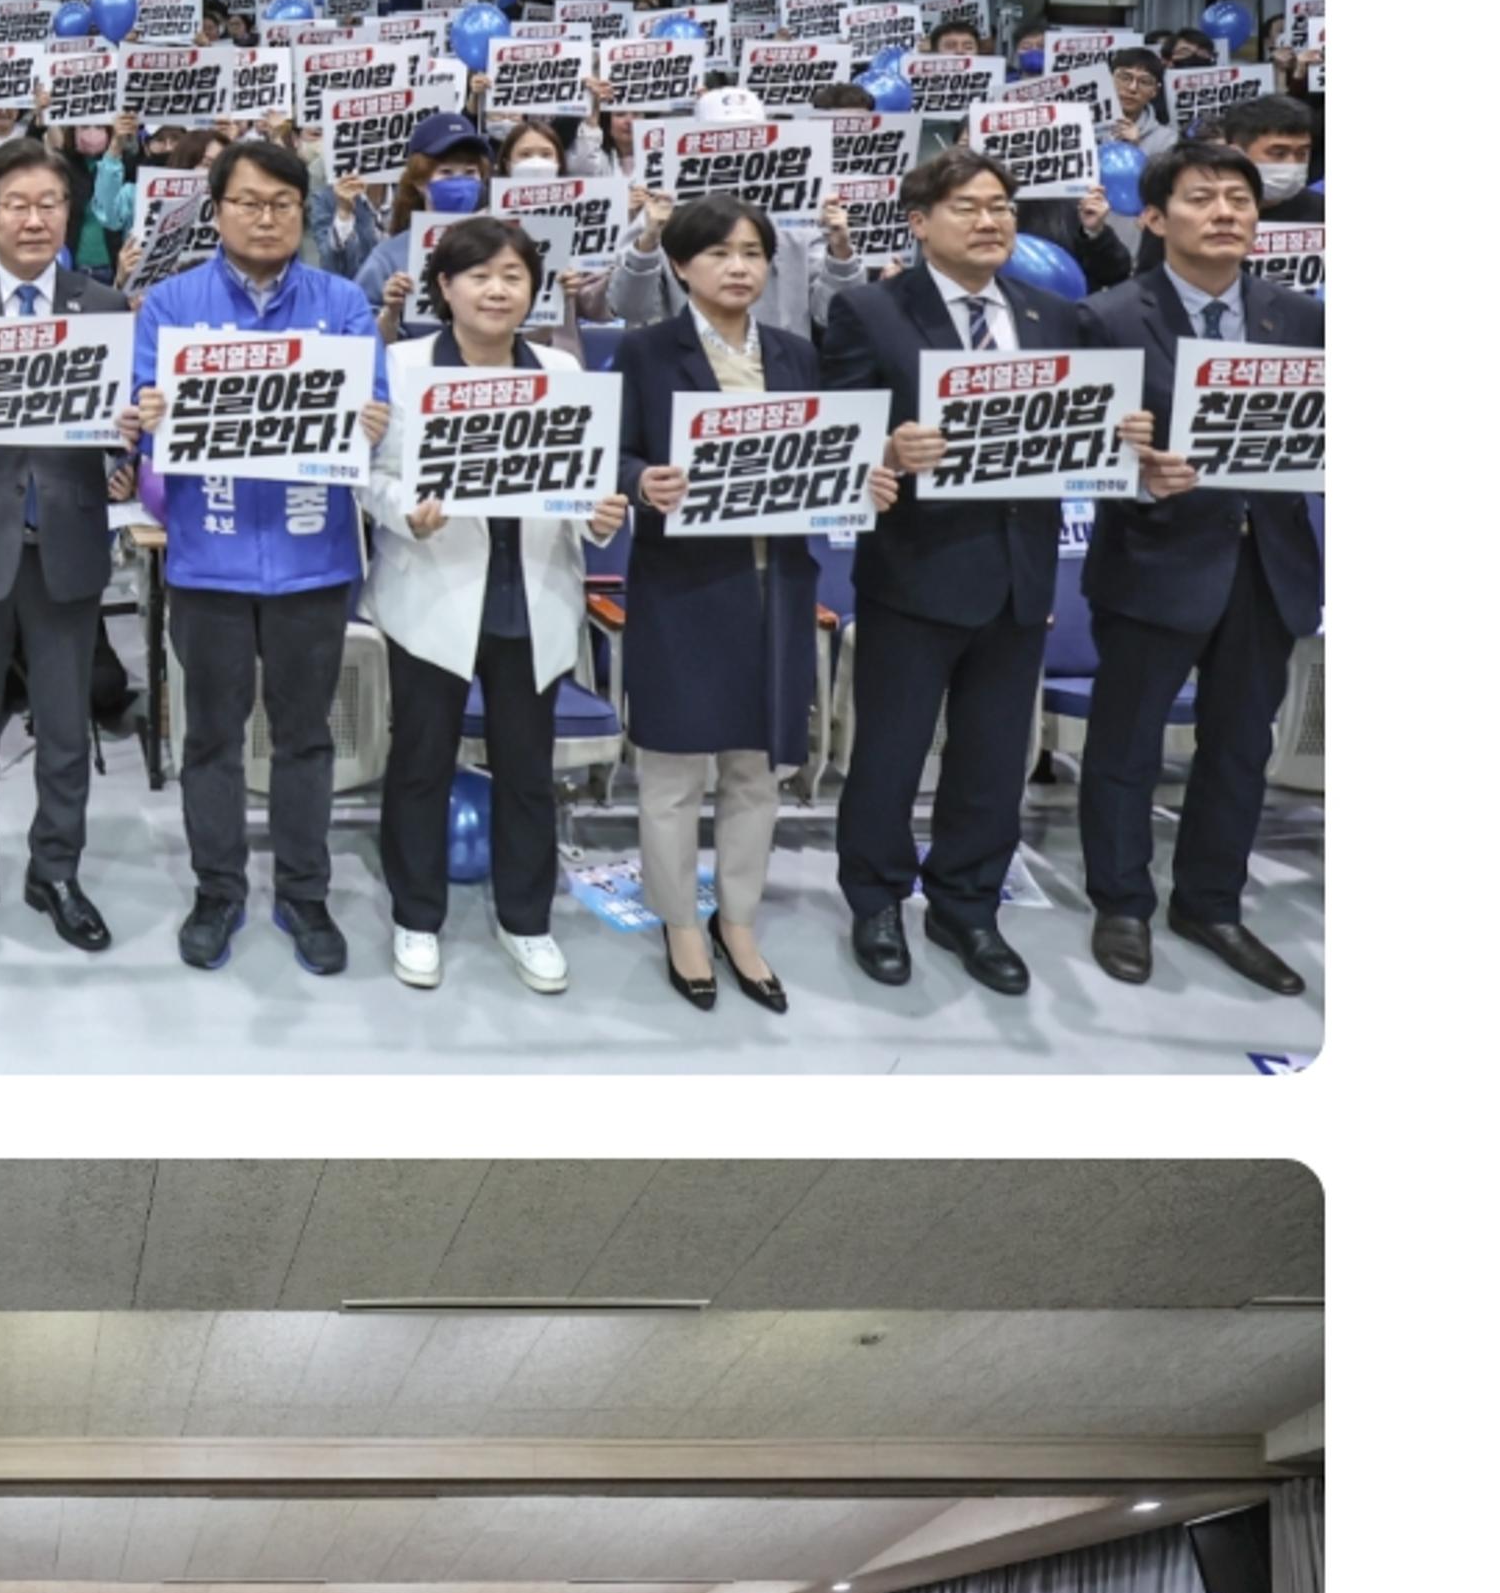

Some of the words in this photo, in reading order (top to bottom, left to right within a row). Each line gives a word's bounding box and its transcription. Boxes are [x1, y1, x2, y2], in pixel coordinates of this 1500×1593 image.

[675, 147, 811, 188] 친일야합
[1011, 150, 1093, 186] 탄한다!
[185, 343, 291, 372] 윤석열정권
[949, 361, 1056, 394] 윤석열정권
[171, 370, 346, 417] 친일야합
[432, 378, 536, 411] 윤석열정권
[940, 383, 1115, 441] 친일야합
[168, 411, 357, 461] 규탄한다!
[419, 406, 592, 459] 친일야합
[700, 401, 807, 435] 윤석열정권
[417, 448, 605, 503] 규탄한다!
[688, 424, 861, 481] 친일야합
[932, 425, 1120, 488] 규탄한다!
[681, 465, 870, 524] 규탄한다!
